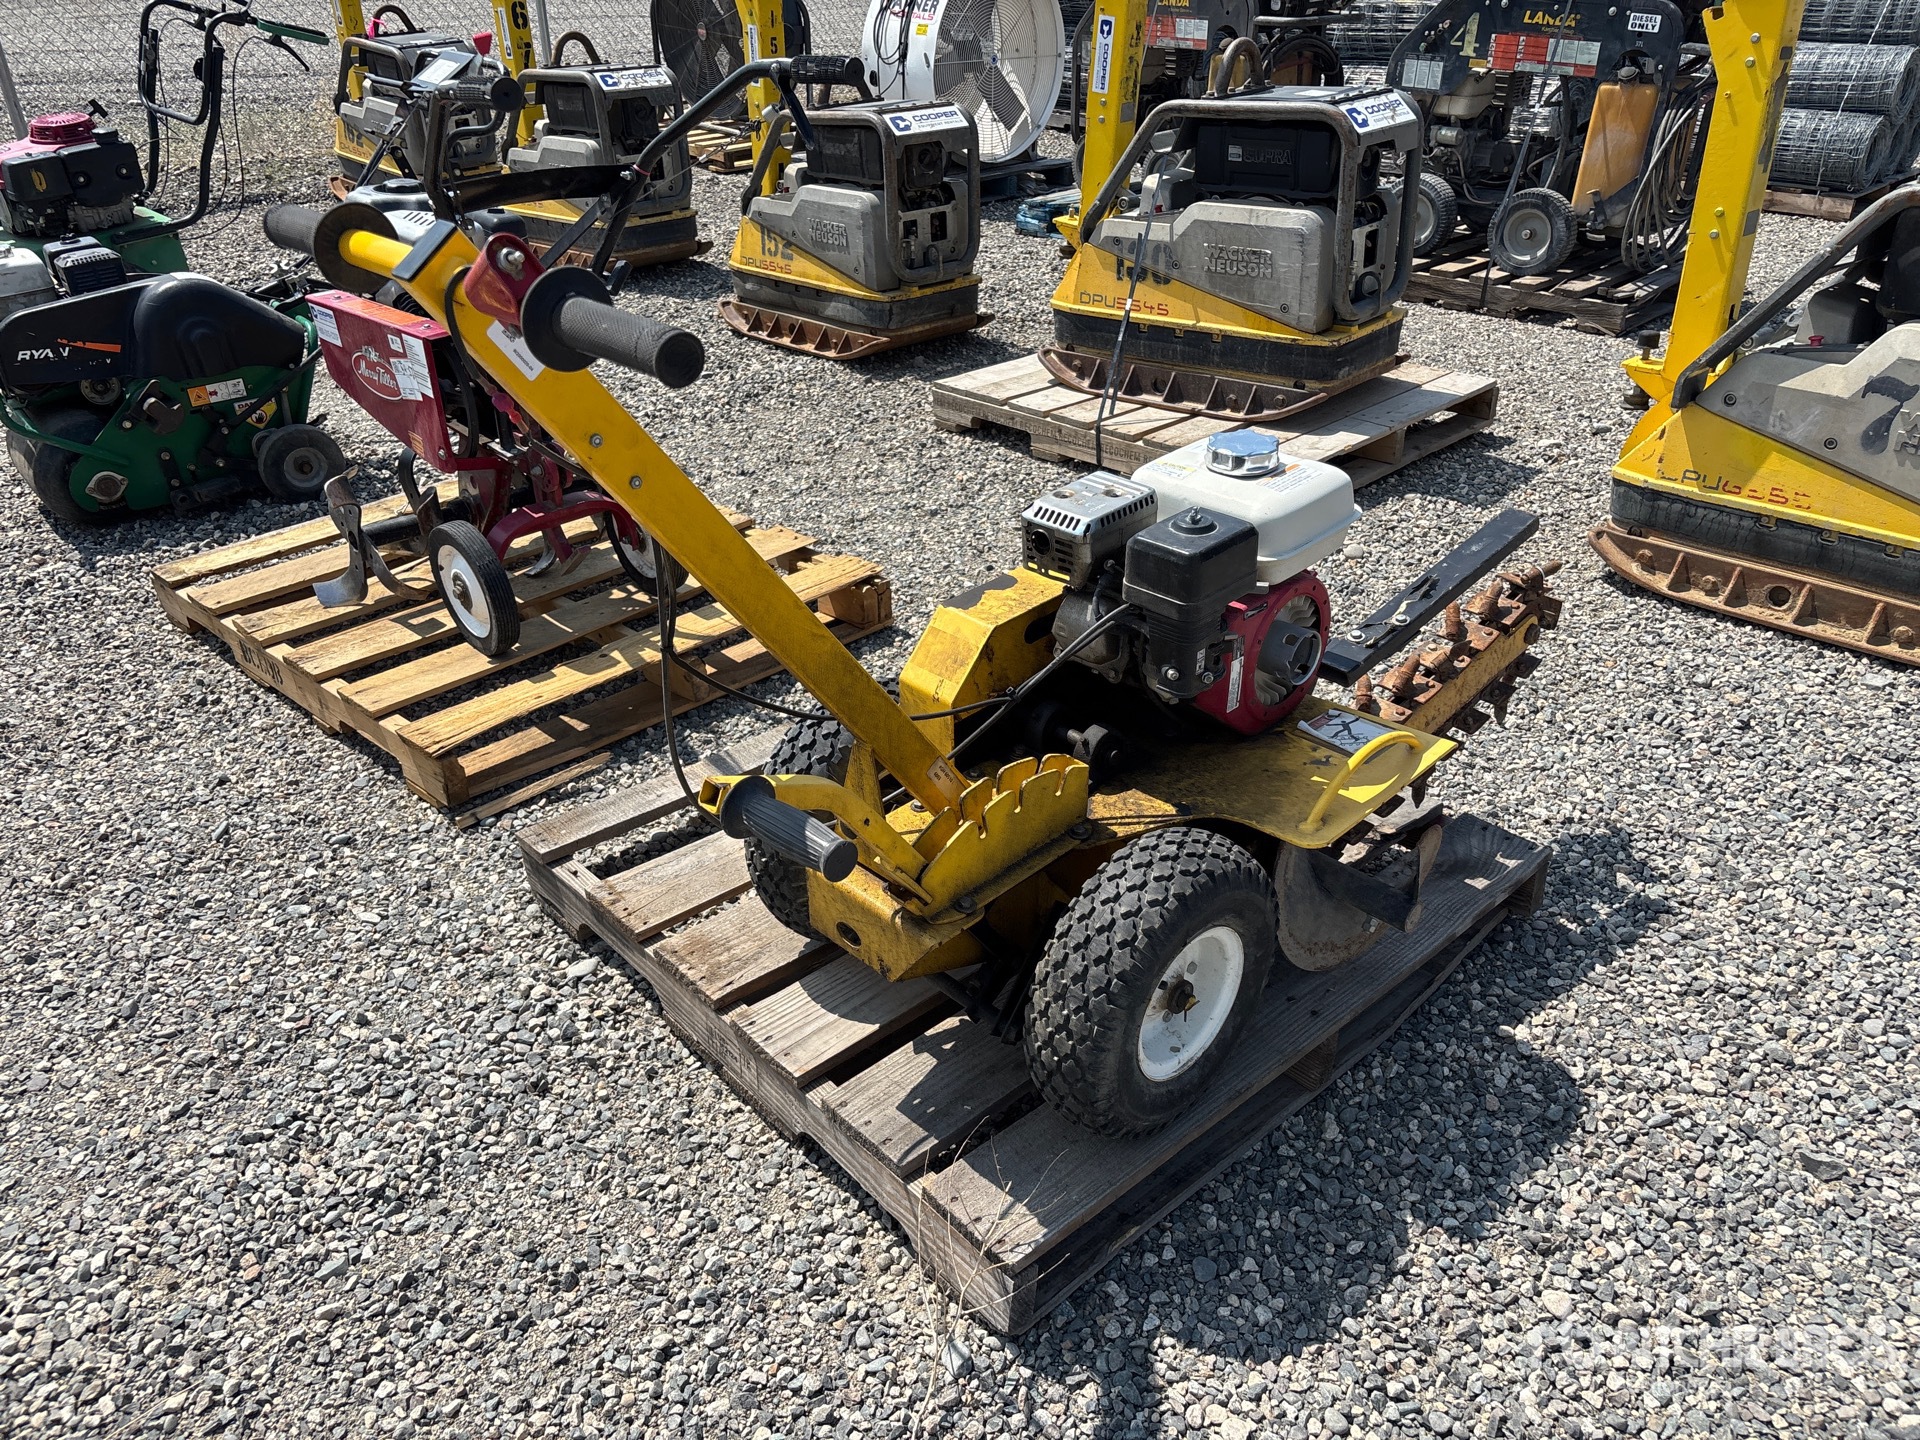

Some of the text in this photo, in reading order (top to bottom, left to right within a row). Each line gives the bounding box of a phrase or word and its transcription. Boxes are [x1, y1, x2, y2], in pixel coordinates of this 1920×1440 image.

[1630, 21, 1657, 31] ONLY
[1632, 14, 1659, 23] DIESEL
[1450, 12, 1480, 57] 4
[620, 70, 665, 80] COOPER
[1099, 43, 1110, 91] COOPER
[911, 110, 959, 122] COOPER
[1364, 98, 1404, 115] COOPER
[807, 217, 848, 236] WACKER
[760, 225, 794, 261] 152
[808, 228, 847, 248] NEUSON
[1203, 242, 1273, 265] WACKER
[1203, 256, 1273, 279] NEUSON
[1101, 444, 1141, 462] RECOCHEM
